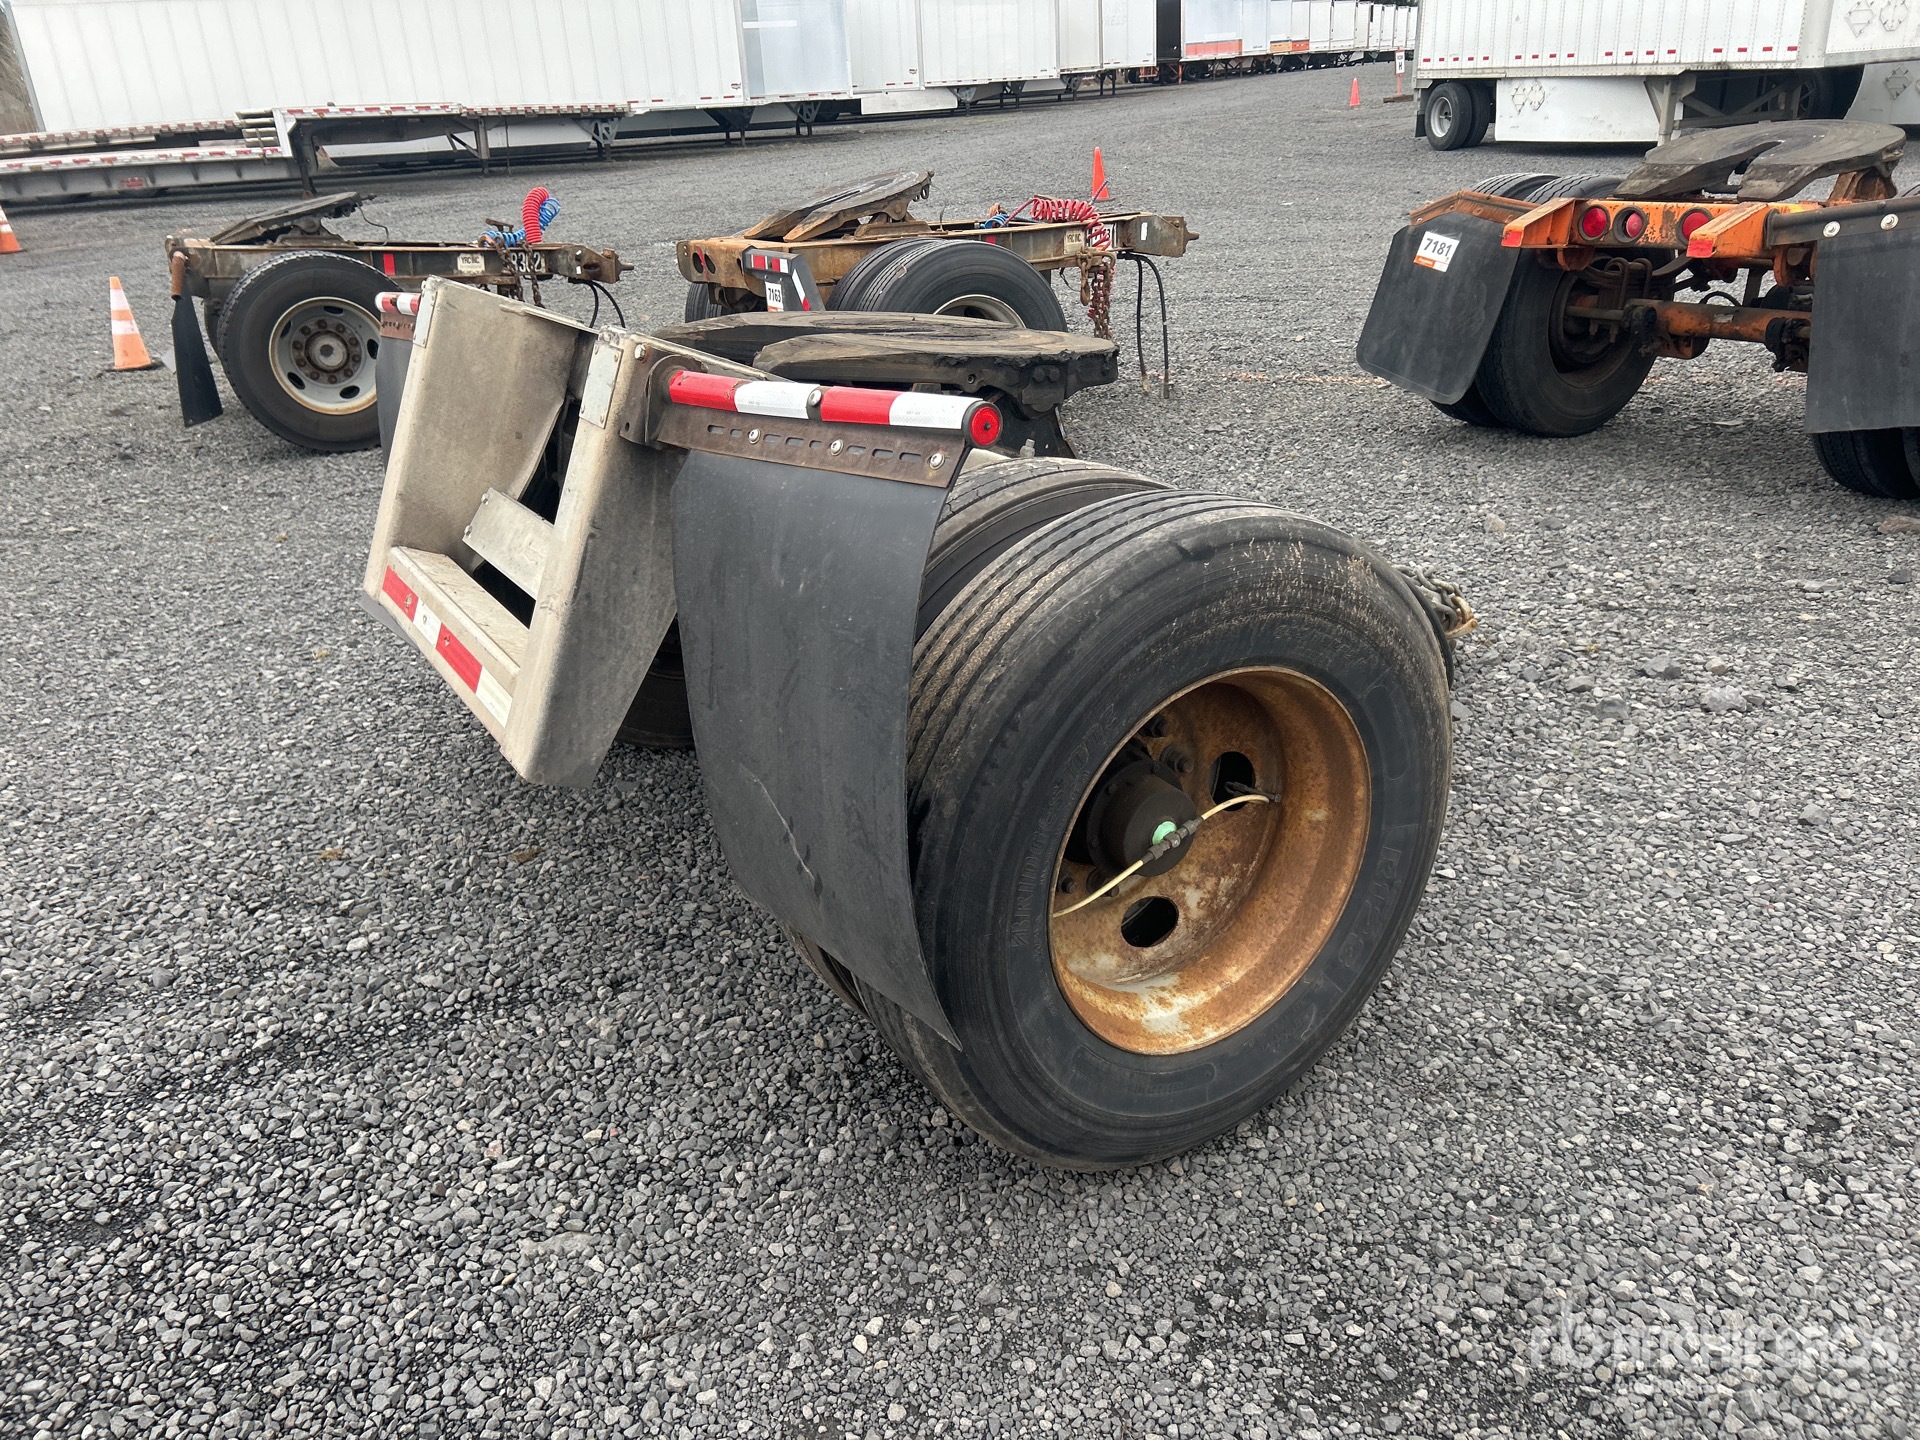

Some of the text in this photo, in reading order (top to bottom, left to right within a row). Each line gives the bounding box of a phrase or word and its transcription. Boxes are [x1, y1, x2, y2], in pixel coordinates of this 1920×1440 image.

[1423, 238, 1453, 257] 7181
[461, 256, 472, 264] YRC
[768, 288, 782, 303] 7163
